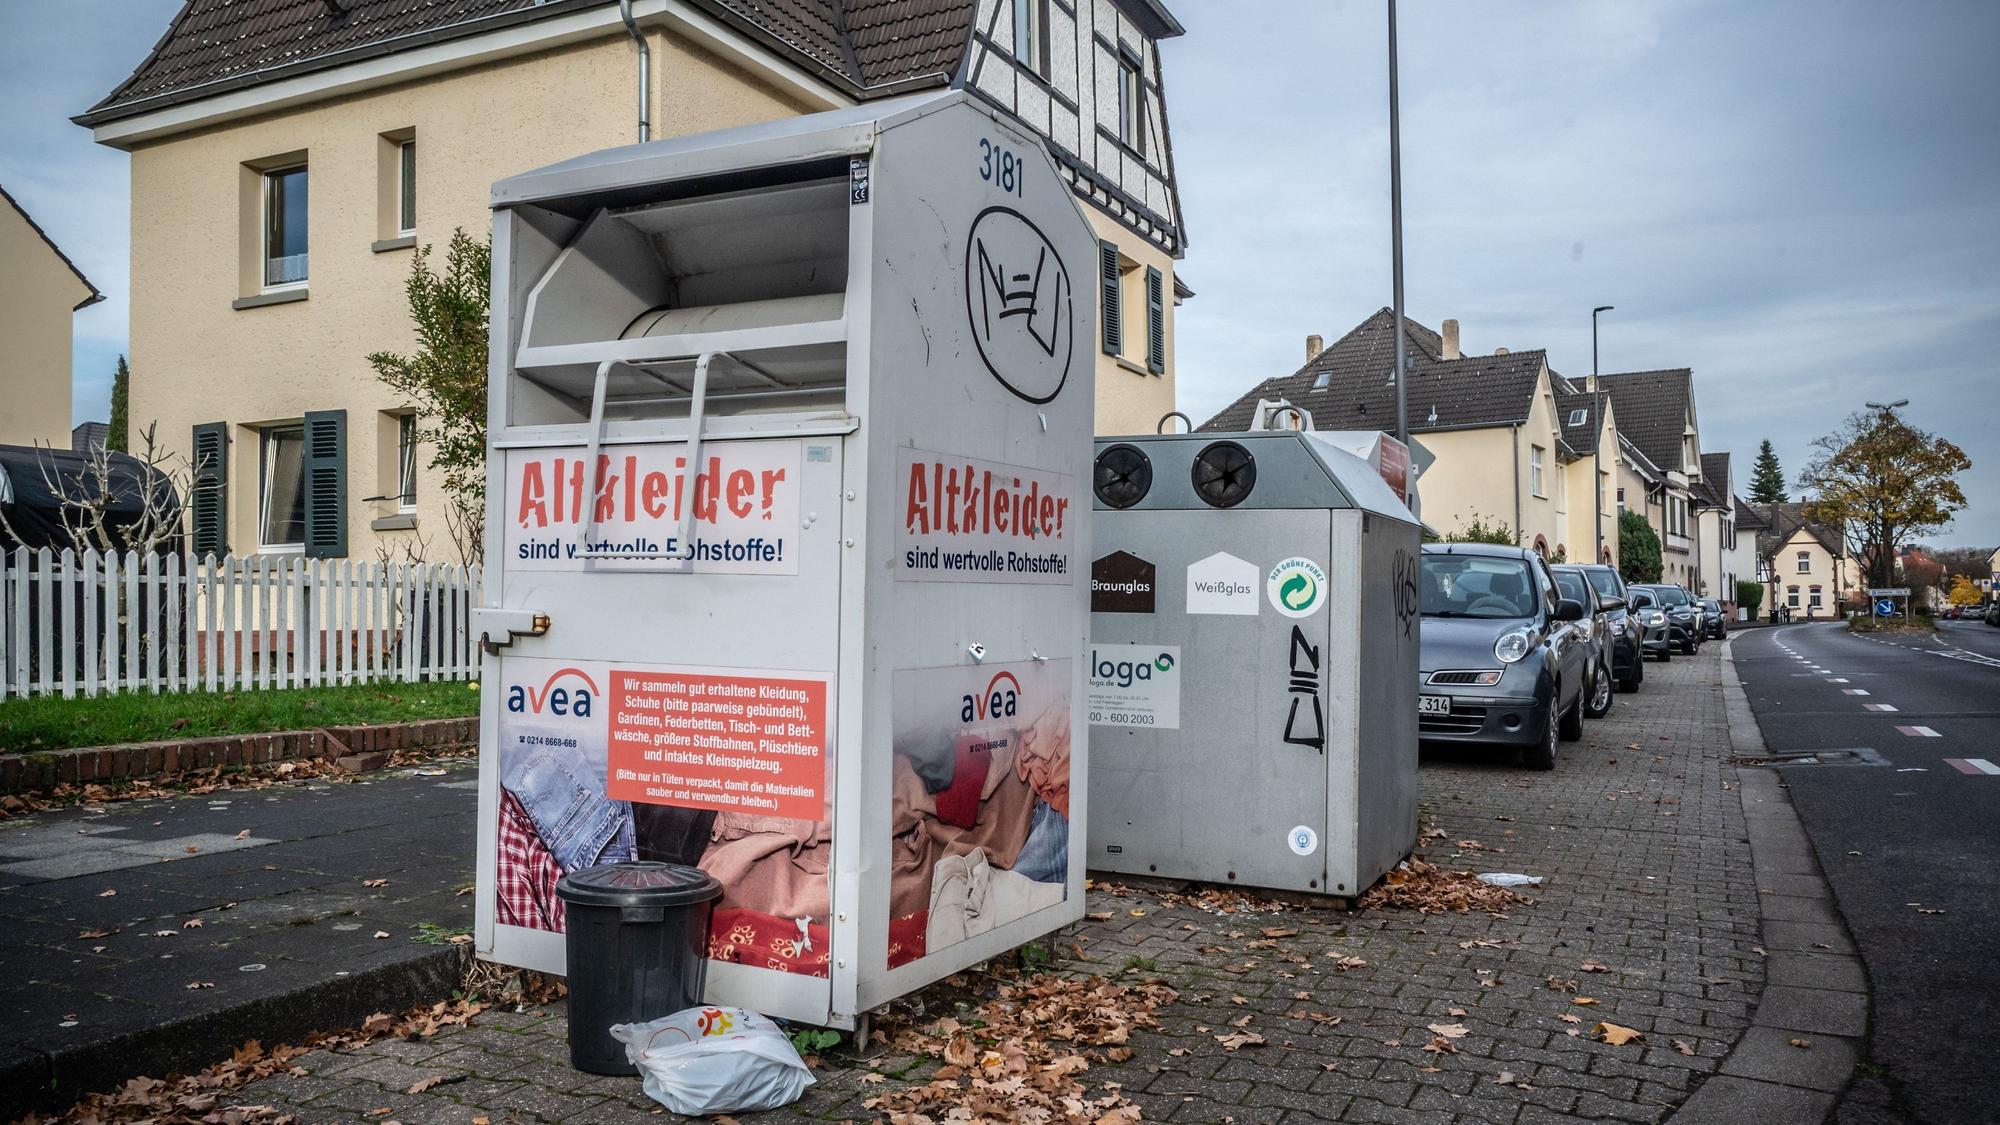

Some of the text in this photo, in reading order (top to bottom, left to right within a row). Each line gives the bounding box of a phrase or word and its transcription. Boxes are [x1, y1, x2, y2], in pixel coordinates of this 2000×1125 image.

[979, 138, 1023, 198] 3181
[519, 454, 786, 529] Altkleider
[907, 462, 1068, 540] Altkleider
[518, 538, 560, 560] sind
[906, 546, 1067, 574] sind wertvolle Rohstoffe!
[1091, 579, 1150, 594] Braunglas
[1195, 582, 1251, 596] Weißglas
[508, 668, 600, 717] avea
[624, 678, 809, 703] Wir sammeln gut erhaltene Kleidung,
[961, 671, 1021, 722] avea
[625, 695, 806, 721] Schuhe (bitte paarweise gebündelt),
[1425, 698, 1447, 711] 314
[618, 712, 814, 737] Gardinen, Federbetten, Tisch- und Bett-
[1088, 712, 1101, 721] 00
[1111, 713, 1128, 723] 600
[1130, 714, 1154, 724] 2003
[527, 736, 576, 747] 0214 8668-668
[614, 729, 818, 756] wäsche, größere Stoffbahnen, Plüschtiere
[644, 749, 782, 773] und intaktes Kleinspielzeug.
[616, 768, 814, 797] (Bitte nur in Tüten verpackt, damit die Materialien
[646, 787, 778, 810] sauber und verwendbar bleiben.)
